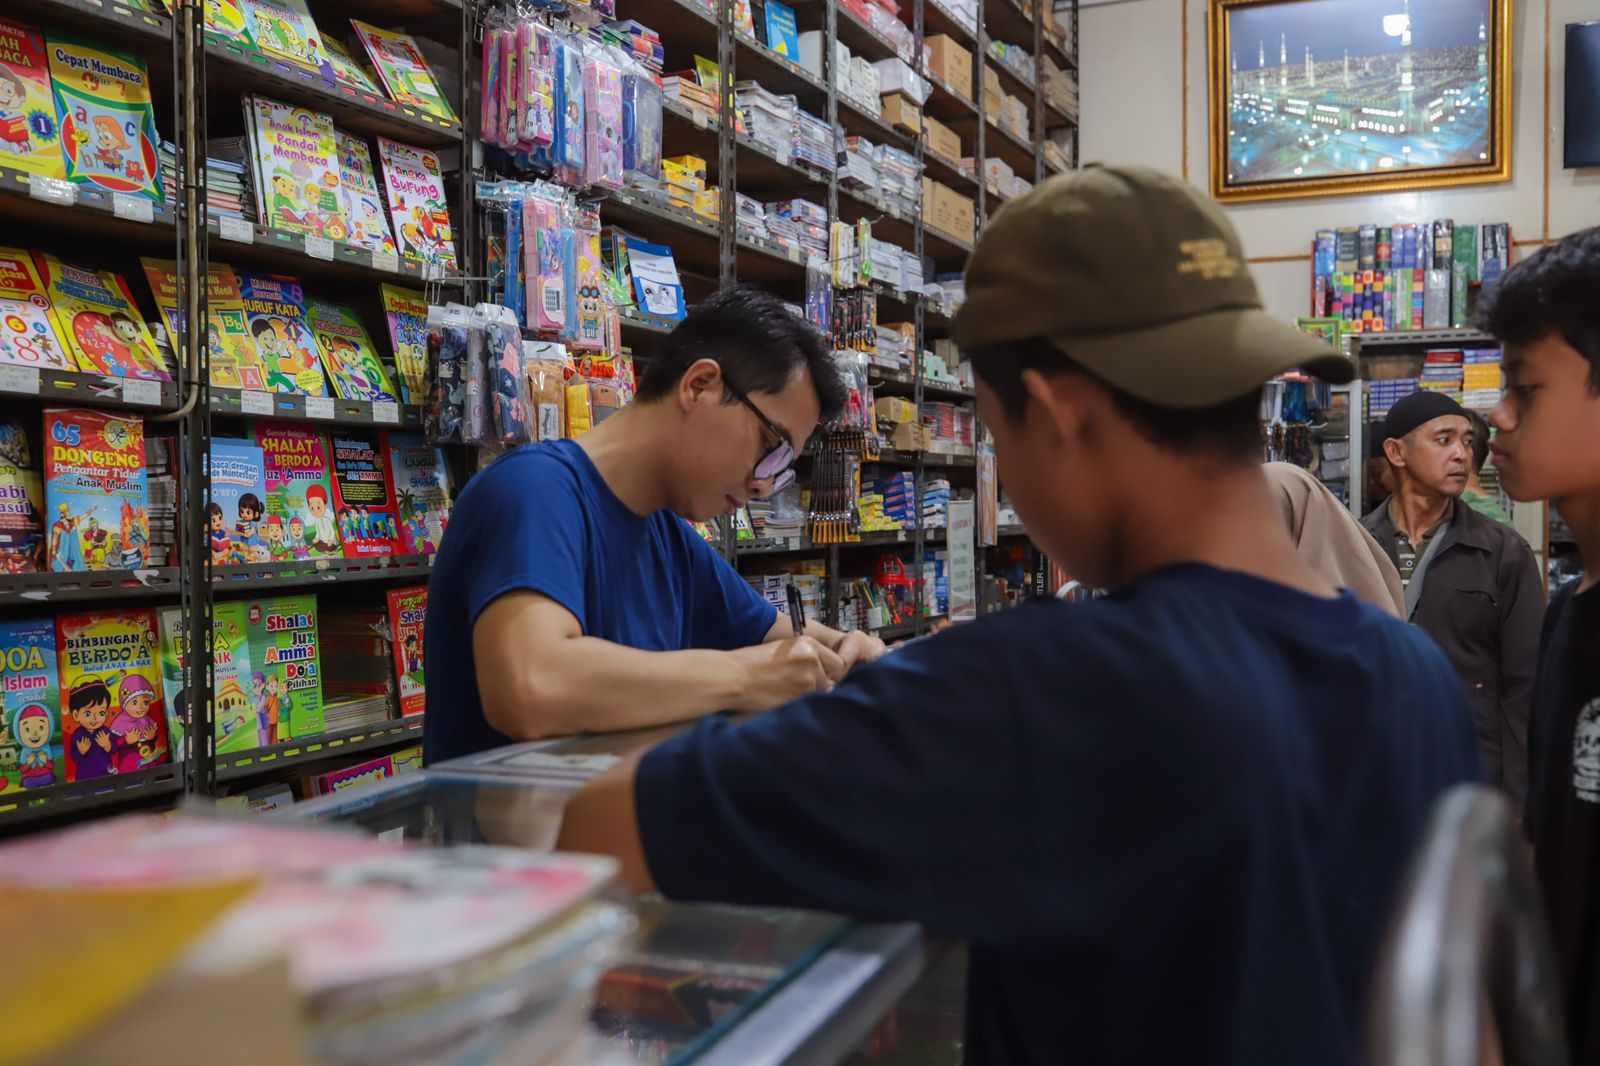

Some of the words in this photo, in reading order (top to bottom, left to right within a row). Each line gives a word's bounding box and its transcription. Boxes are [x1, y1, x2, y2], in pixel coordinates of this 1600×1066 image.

[0, 47, 32, 68] ACA
[55, 48, 89, 68] Cepat
[91, 58, 142, 84] Membaca
[39, 119, 47, 134] 1
[269, 119, 294, 134] Anak
[295, 126, 321, 139] Islam
[276, 132, 318, 152] Pandai
[273, 145, 329, 167] Membaca
[340, 168, 376, 192] enulis
[389, 174, 441, 201] Burung
[242, 299, 274, 315] HURUF
[275, 303, 301, 318] KATA
[223, 315, 243, 331] Bb
[245, 370, 258, 386] A
[52, 420, 81, 446] 65
[261, 438, 314, 454] SHALAT
[336, 449, 375, 461] SHALAT
[53, 446, 141, 469] DONGENG
[274, 454, 322, 468] BERDO'A
[53, 463, 110, 479] Pengantar
[112, 467, 142, 480] Tidur
[230, 462, 258, 473] dengan
[76, 477, 103, 489] Anak
[106, 481, 142, 492] Muslim
[265, 611, 315, 632] Shalat
[67, 633, 140, 649] BIMBINGAN
[291, 630, 315, 646] Juz
[68, 645, 151, 666] BERDO'A
[264, 645, 316, 665] Amma
[286, 660, 317, 679] Do'a
[4, 673, 48, 692] Islam
[287, 678, 318, 691] Pilihan
